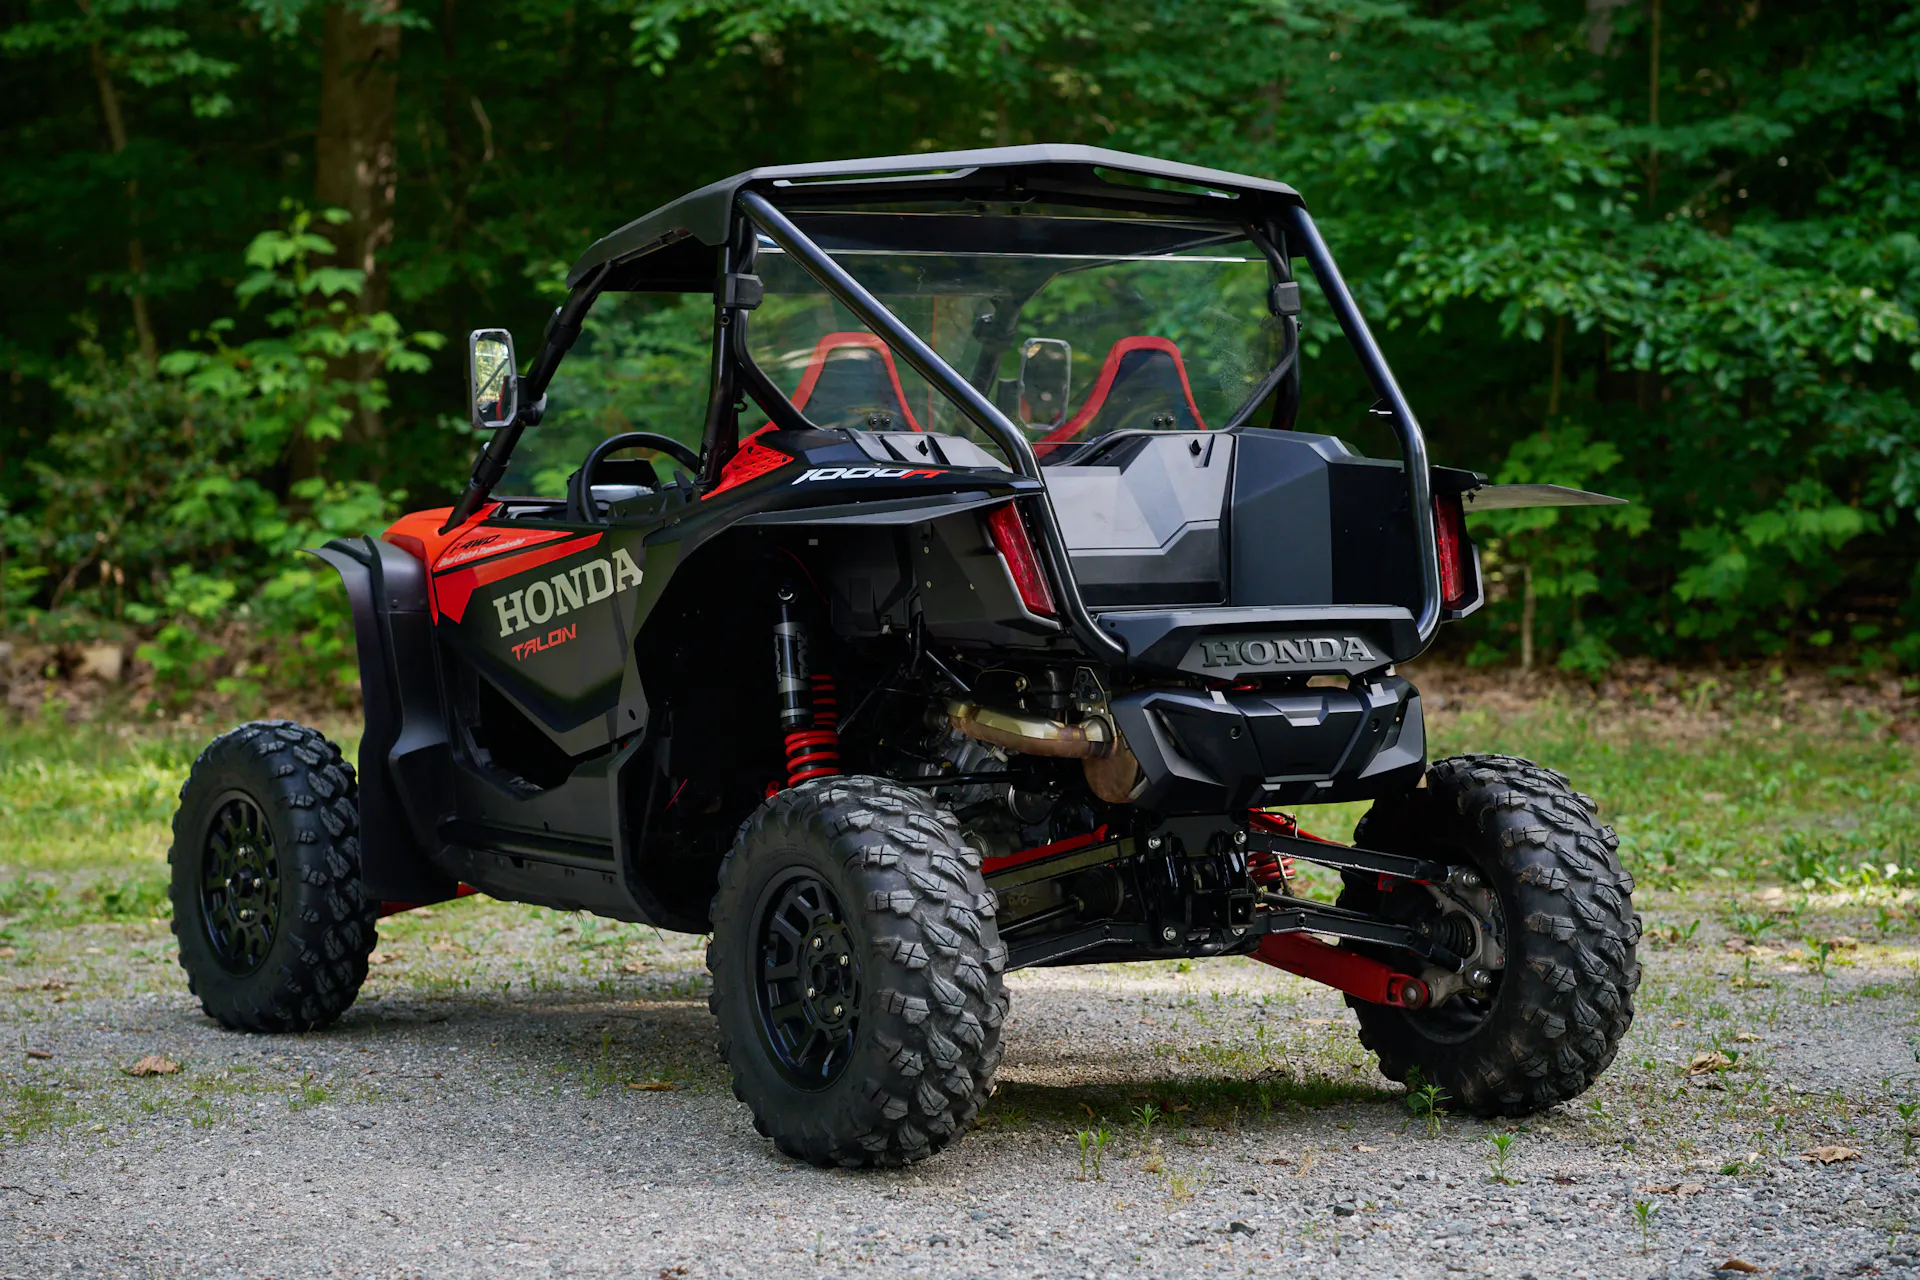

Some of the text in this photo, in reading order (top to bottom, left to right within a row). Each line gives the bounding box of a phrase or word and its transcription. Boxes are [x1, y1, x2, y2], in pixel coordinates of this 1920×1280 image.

[492, 547, 644, 638] HONDA
[511, 623, 577, 662] TALON
[1200, 636, 1376, 668] HONDA
